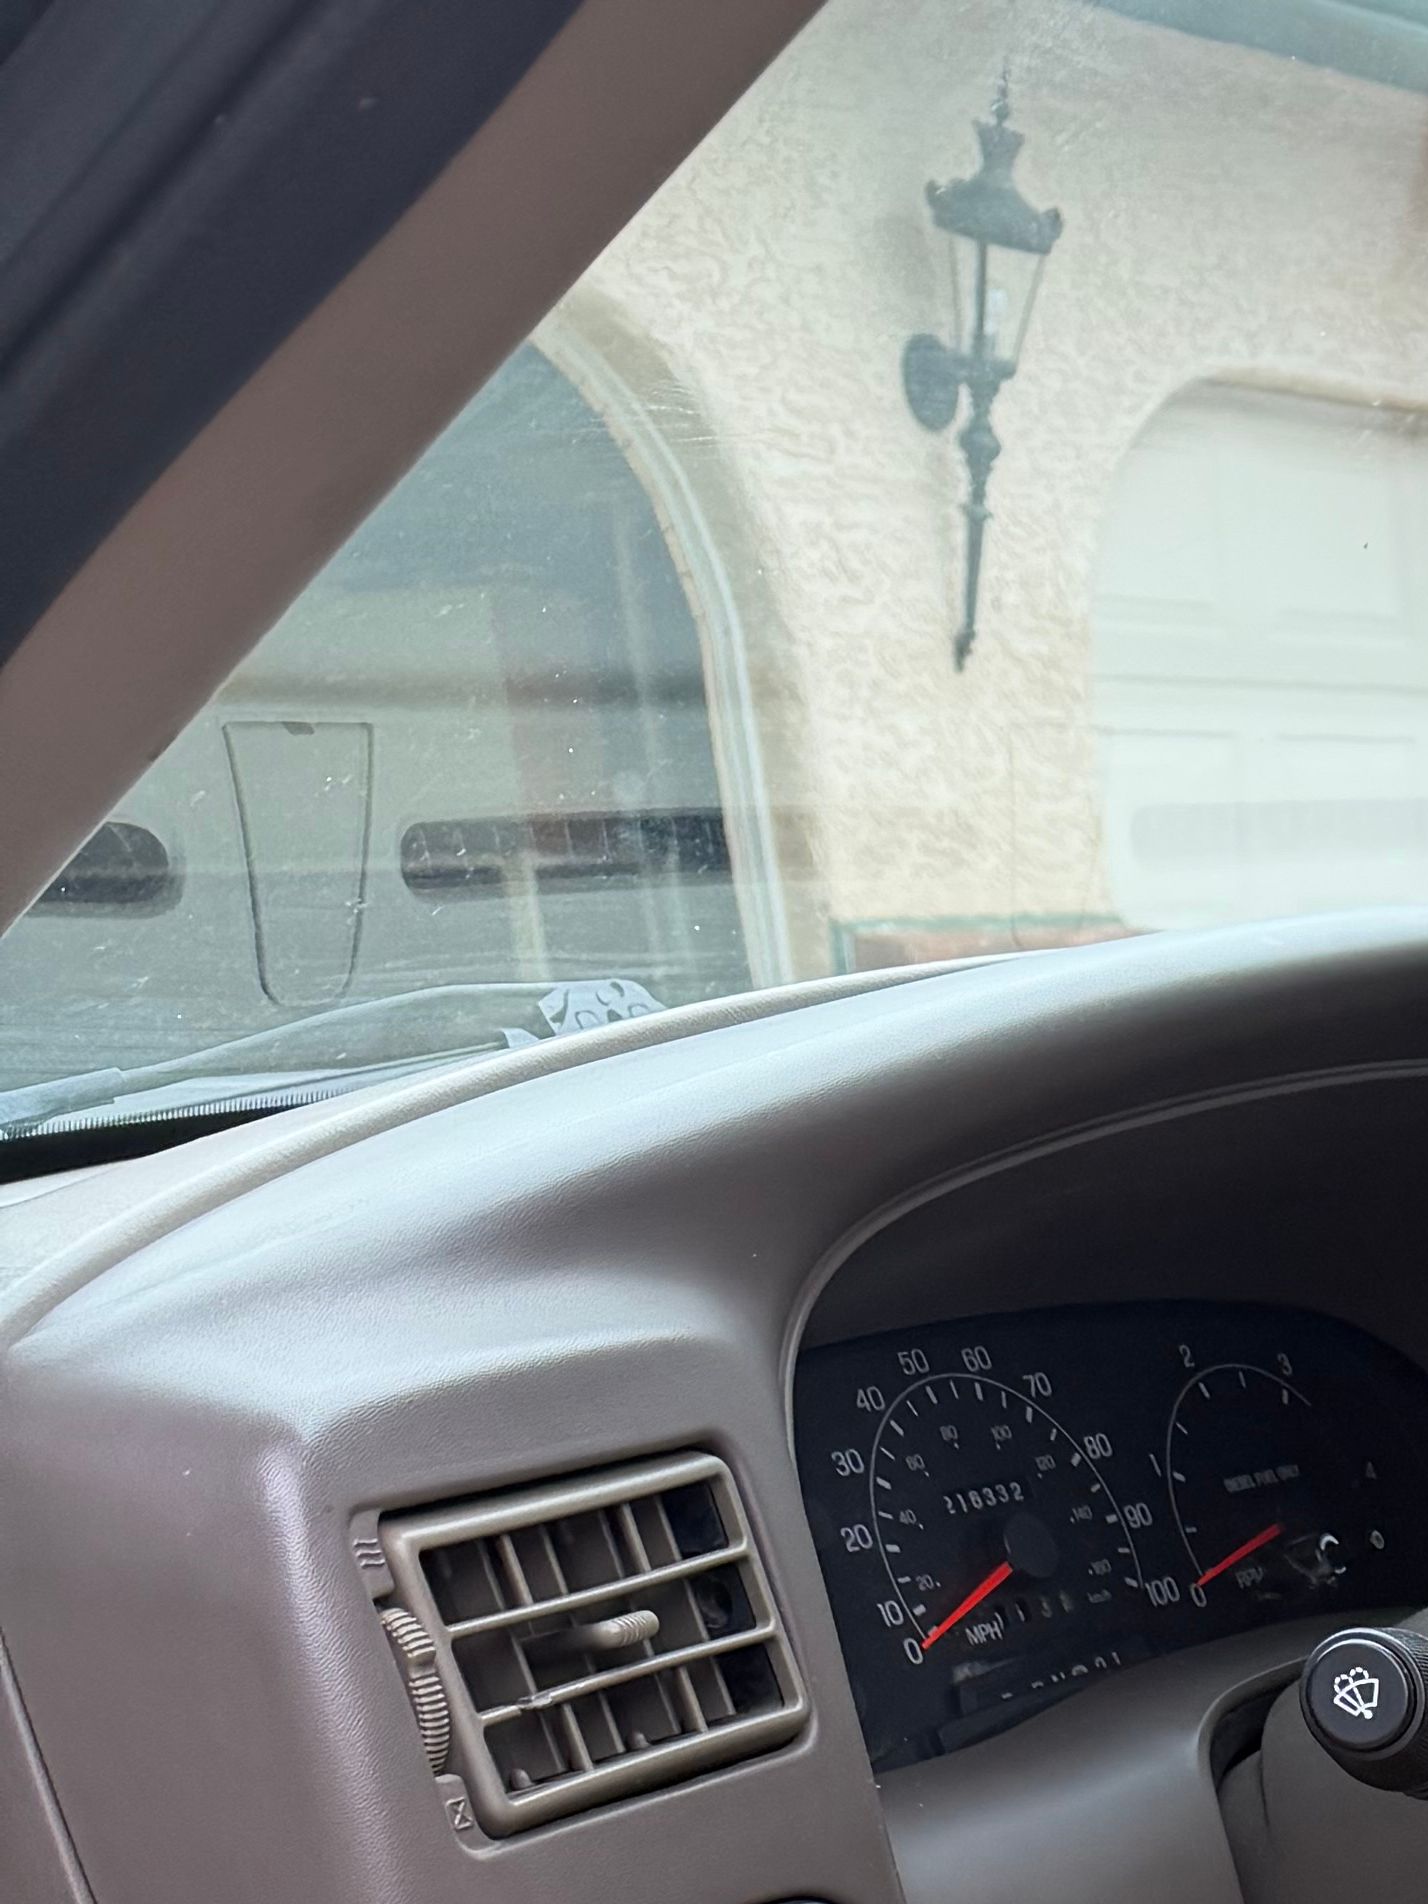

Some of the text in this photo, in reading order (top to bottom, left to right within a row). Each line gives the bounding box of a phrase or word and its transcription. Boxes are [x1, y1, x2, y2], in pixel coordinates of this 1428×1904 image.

[897, 1348, 930, 1376] 50
[961, 1345, 992, 1371] 60
[1178, 1343, 1196, 1368] 2
[1276, 1352, 1293, 1376] 3
[1022, 1371, 1052, 1398] 70
[855, 1386, 886, 1412] 40
[1083, 1433, 1113, 1459] 80
[831, 1448, 865, 1477] 30
[1124, 1501, 1153, 1529] 90
[840, 1523, 874, 1553] 20
[1144, 1576, 1181, 1608] 100
[1190, 1582, 1208, 1608] 0
[877, 1599, 905, 1628] 10
[964, 1619, 1005, 1646] MPH
[903, 1637, 924, 1665] 0
